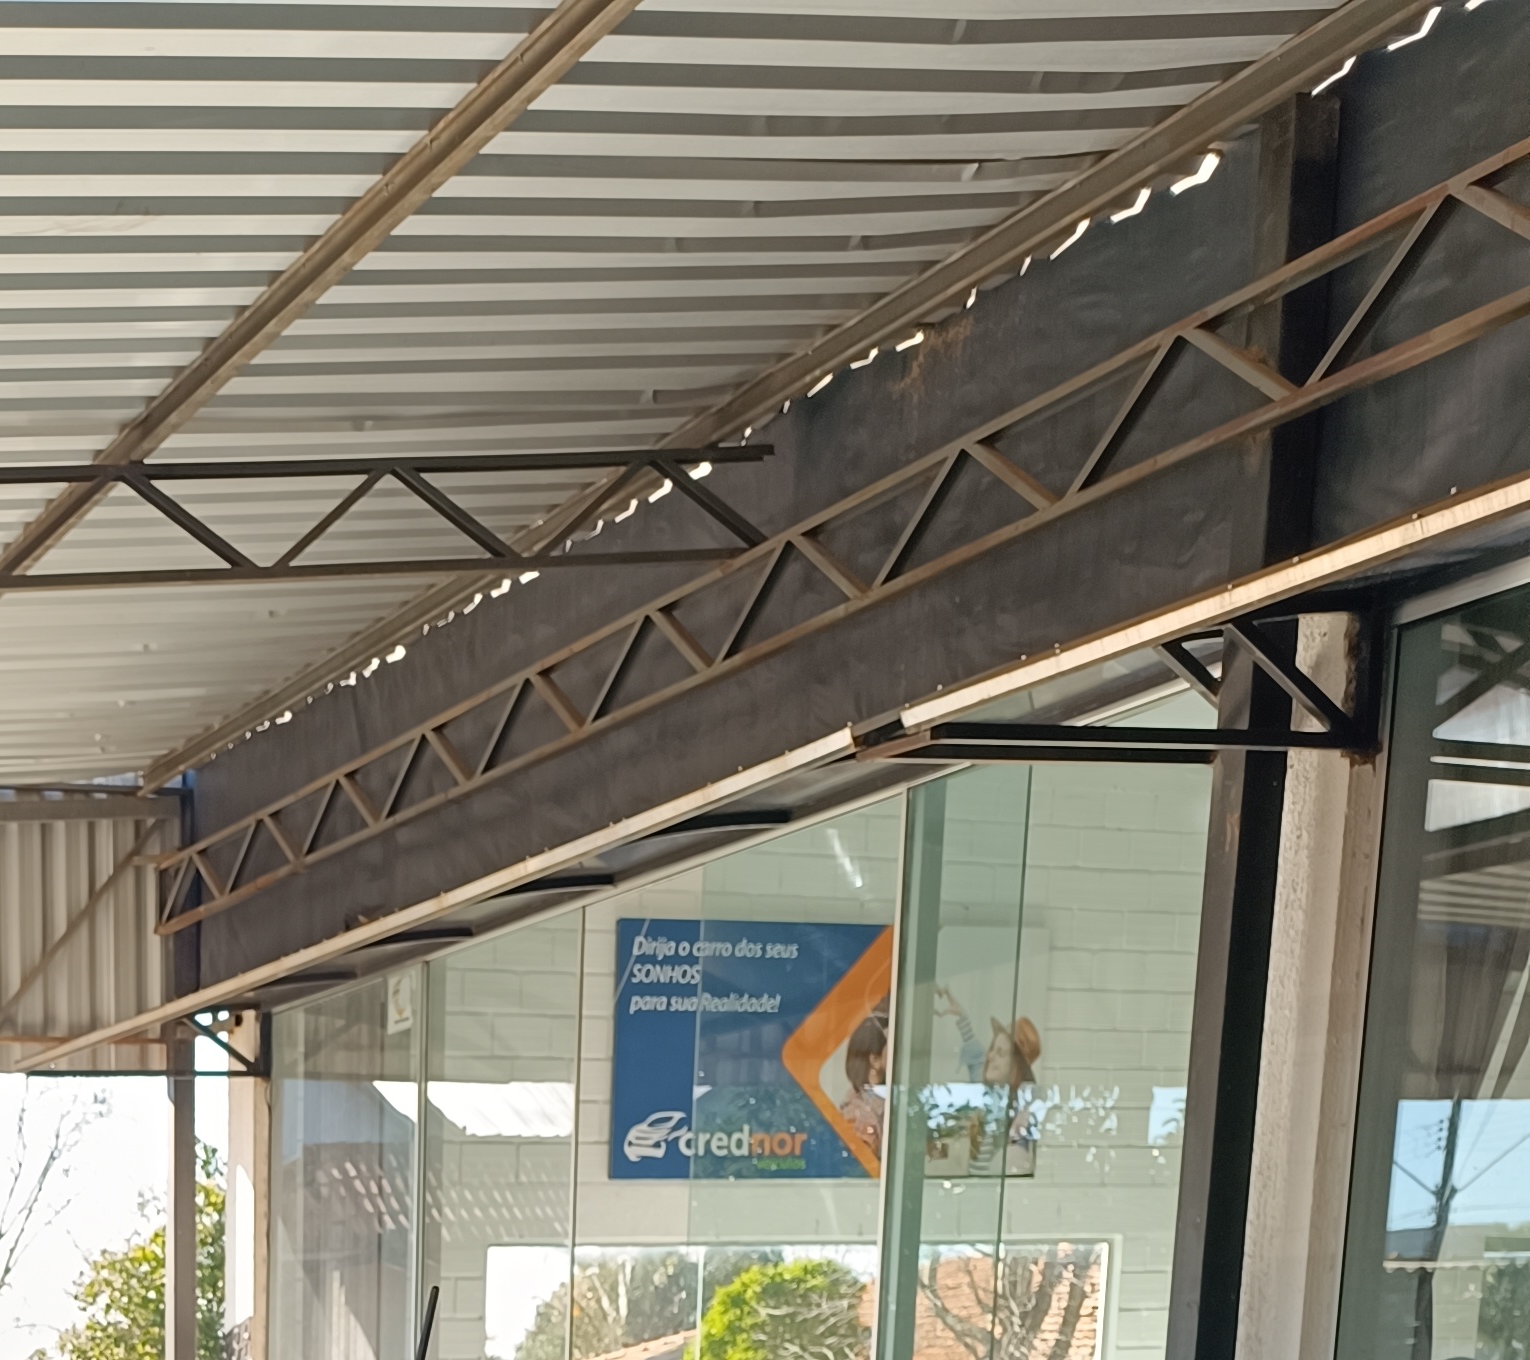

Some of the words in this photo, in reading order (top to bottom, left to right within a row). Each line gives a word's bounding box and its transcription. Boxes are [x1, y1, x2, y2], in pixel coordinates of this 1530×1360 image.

[633, 936, 676, 960] Dirija
[678, 941, 690, 956] o
[692, 941, 732, 957] carro
[734, 937, 763, 957] dos
[765, 942, 798, 959] seus
[631, 964, 701, 984] SONHOS
[629, 995, 668, 1014] para
[669, 996, 698, 1012] sua
[699, 992, 781, 1013] Realidade!
[679, 1124, 807, 1158] crednor
